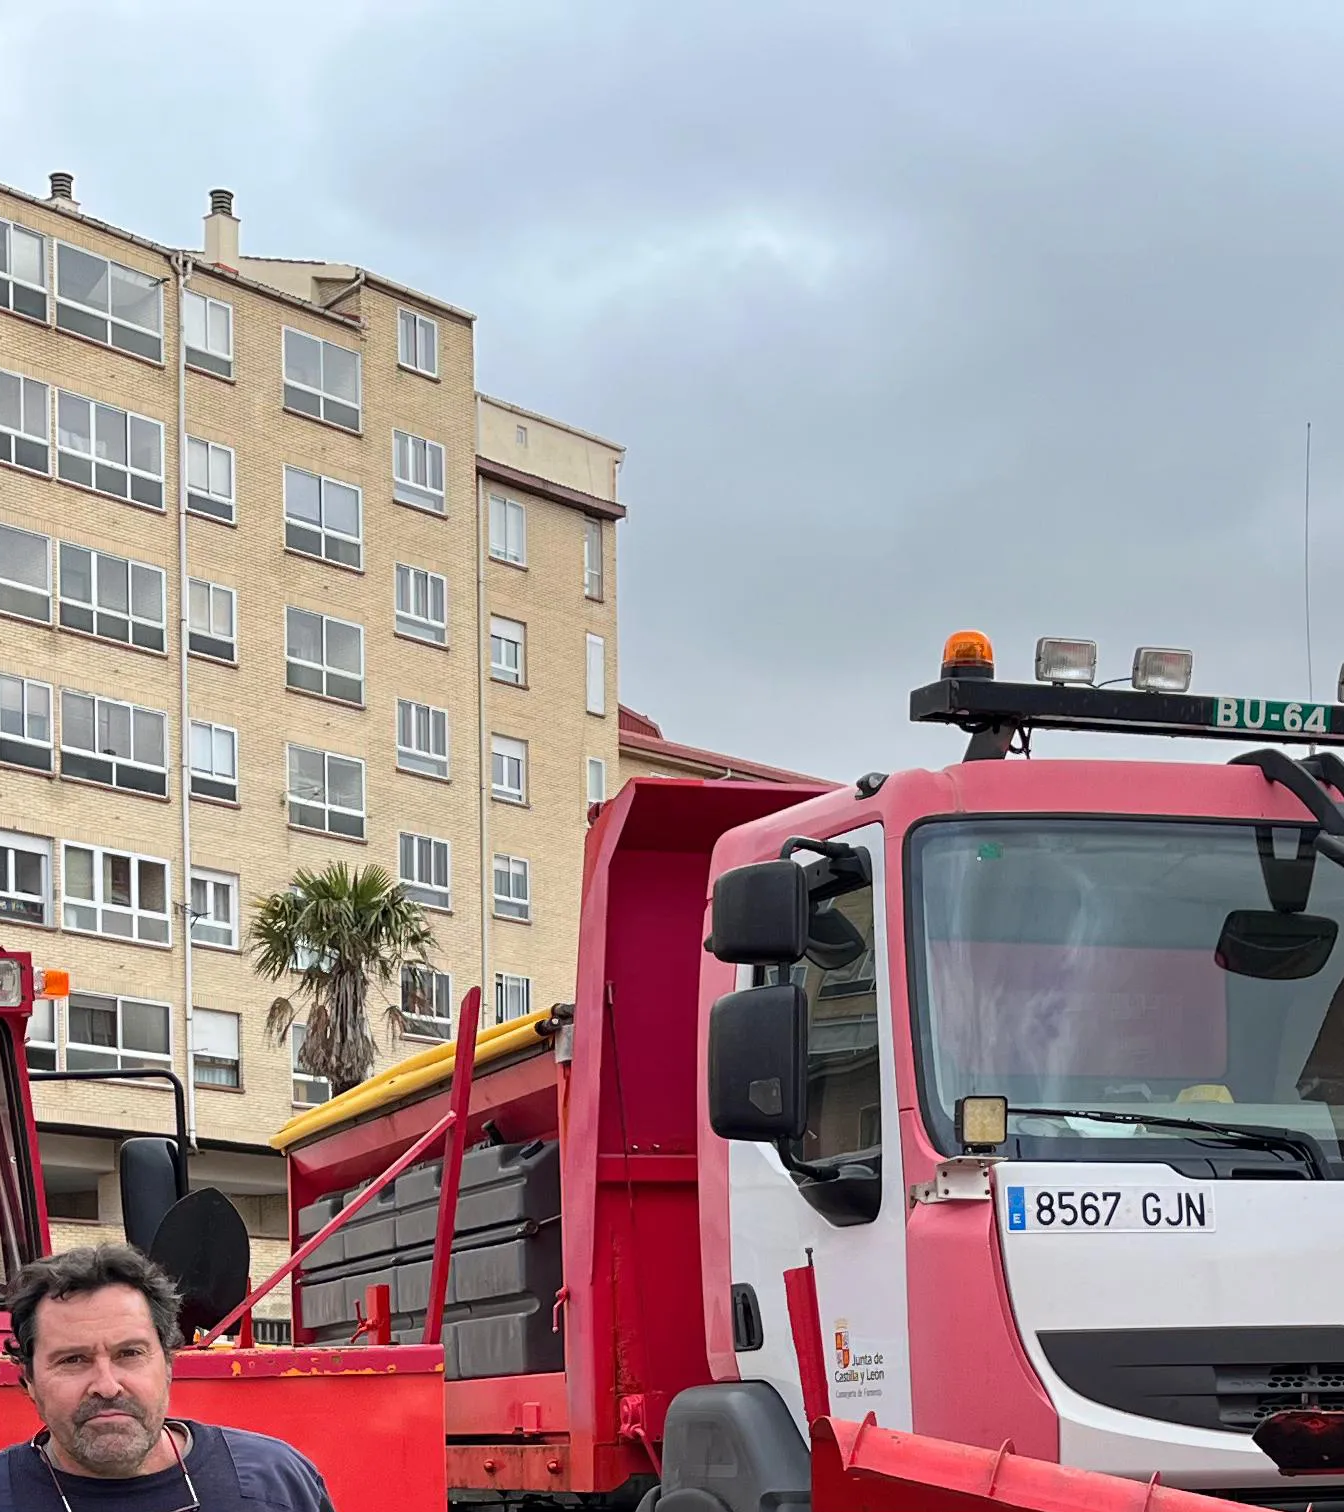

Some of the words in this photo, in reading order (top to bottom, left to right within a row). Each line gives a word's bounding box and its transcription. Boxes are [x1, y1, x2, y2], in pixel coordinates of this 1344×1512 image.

[1216, 697, 1327, 733] BU-64
[1036, 1191, 1121, 1226] 8567
[1142, 1192, 1206, 1227] GJN
[1012, 1213, 1022, 1224] E
[852, 1353, 872, 1366] Junta
[874, 1352, 884, 1365] de
[835, 1370, 859, 1383] Castilla
